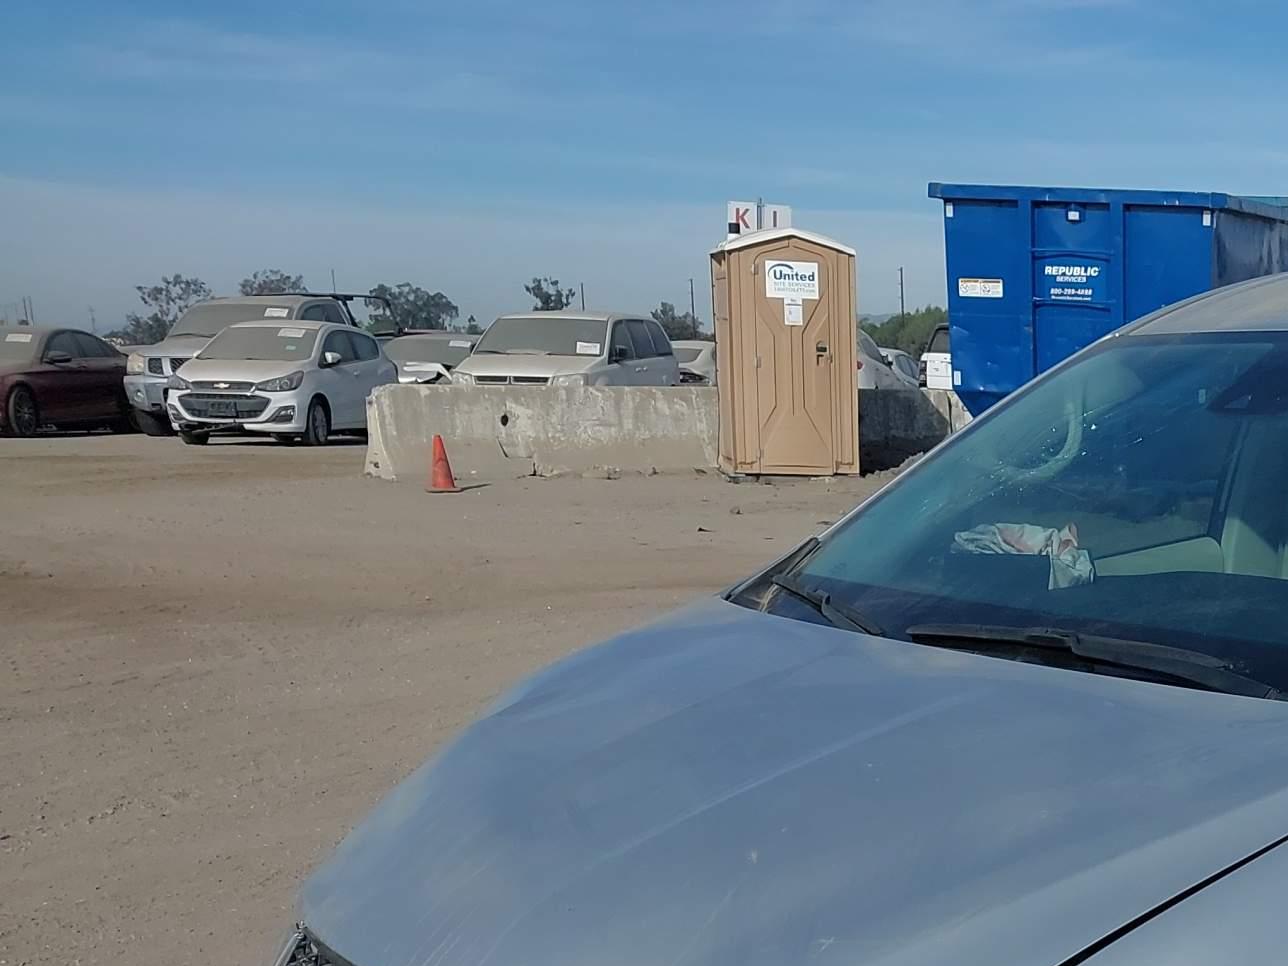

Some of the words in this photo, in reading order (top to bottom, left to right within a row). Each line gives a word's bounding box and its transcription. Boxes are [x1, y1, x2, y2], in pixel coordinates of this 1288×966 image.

[735, 207, 750, 229] K
[773, 269, 816, 281] United
[1045, 266, 1099, 276] REPUBLIC
[1056, 275, 1087, 283] SERVICES
